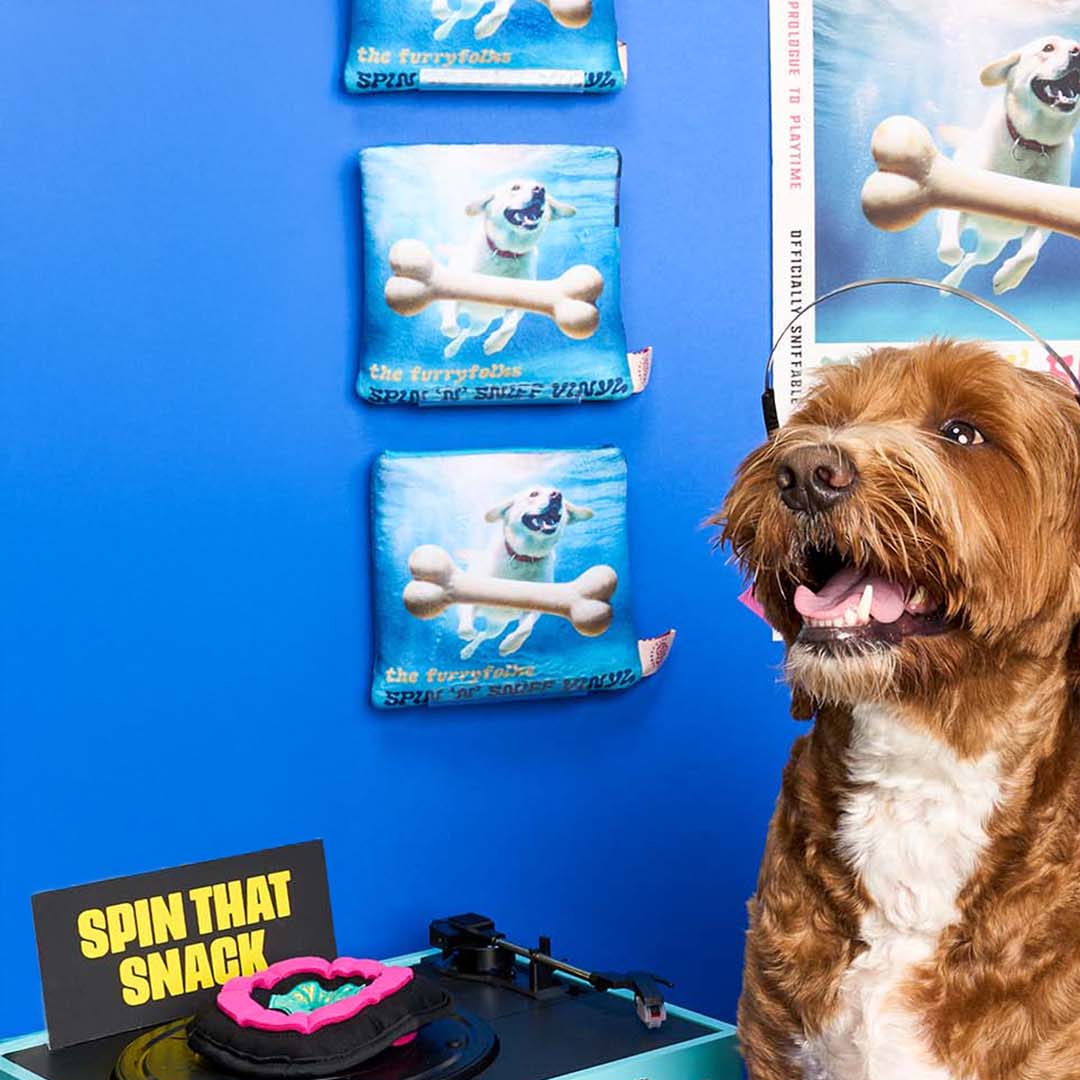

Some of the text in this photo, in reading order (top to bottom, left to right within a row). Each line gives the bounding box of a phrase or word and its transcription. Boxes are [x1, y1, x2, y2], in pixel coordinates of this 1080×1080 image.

[357, 47, 513, 67] the furryfolks
[787, 1, 801, 190] PROLOGUE TO PLAYTIME
[790, 230, 802, 315] OFFICIALLY
[369, 363, 523, 382] the furryfolks
[385, 667, 417, 683] the
[77, 870, 292, 959] SPIN THAT
[119, 929, 270, 1006] SNACK
